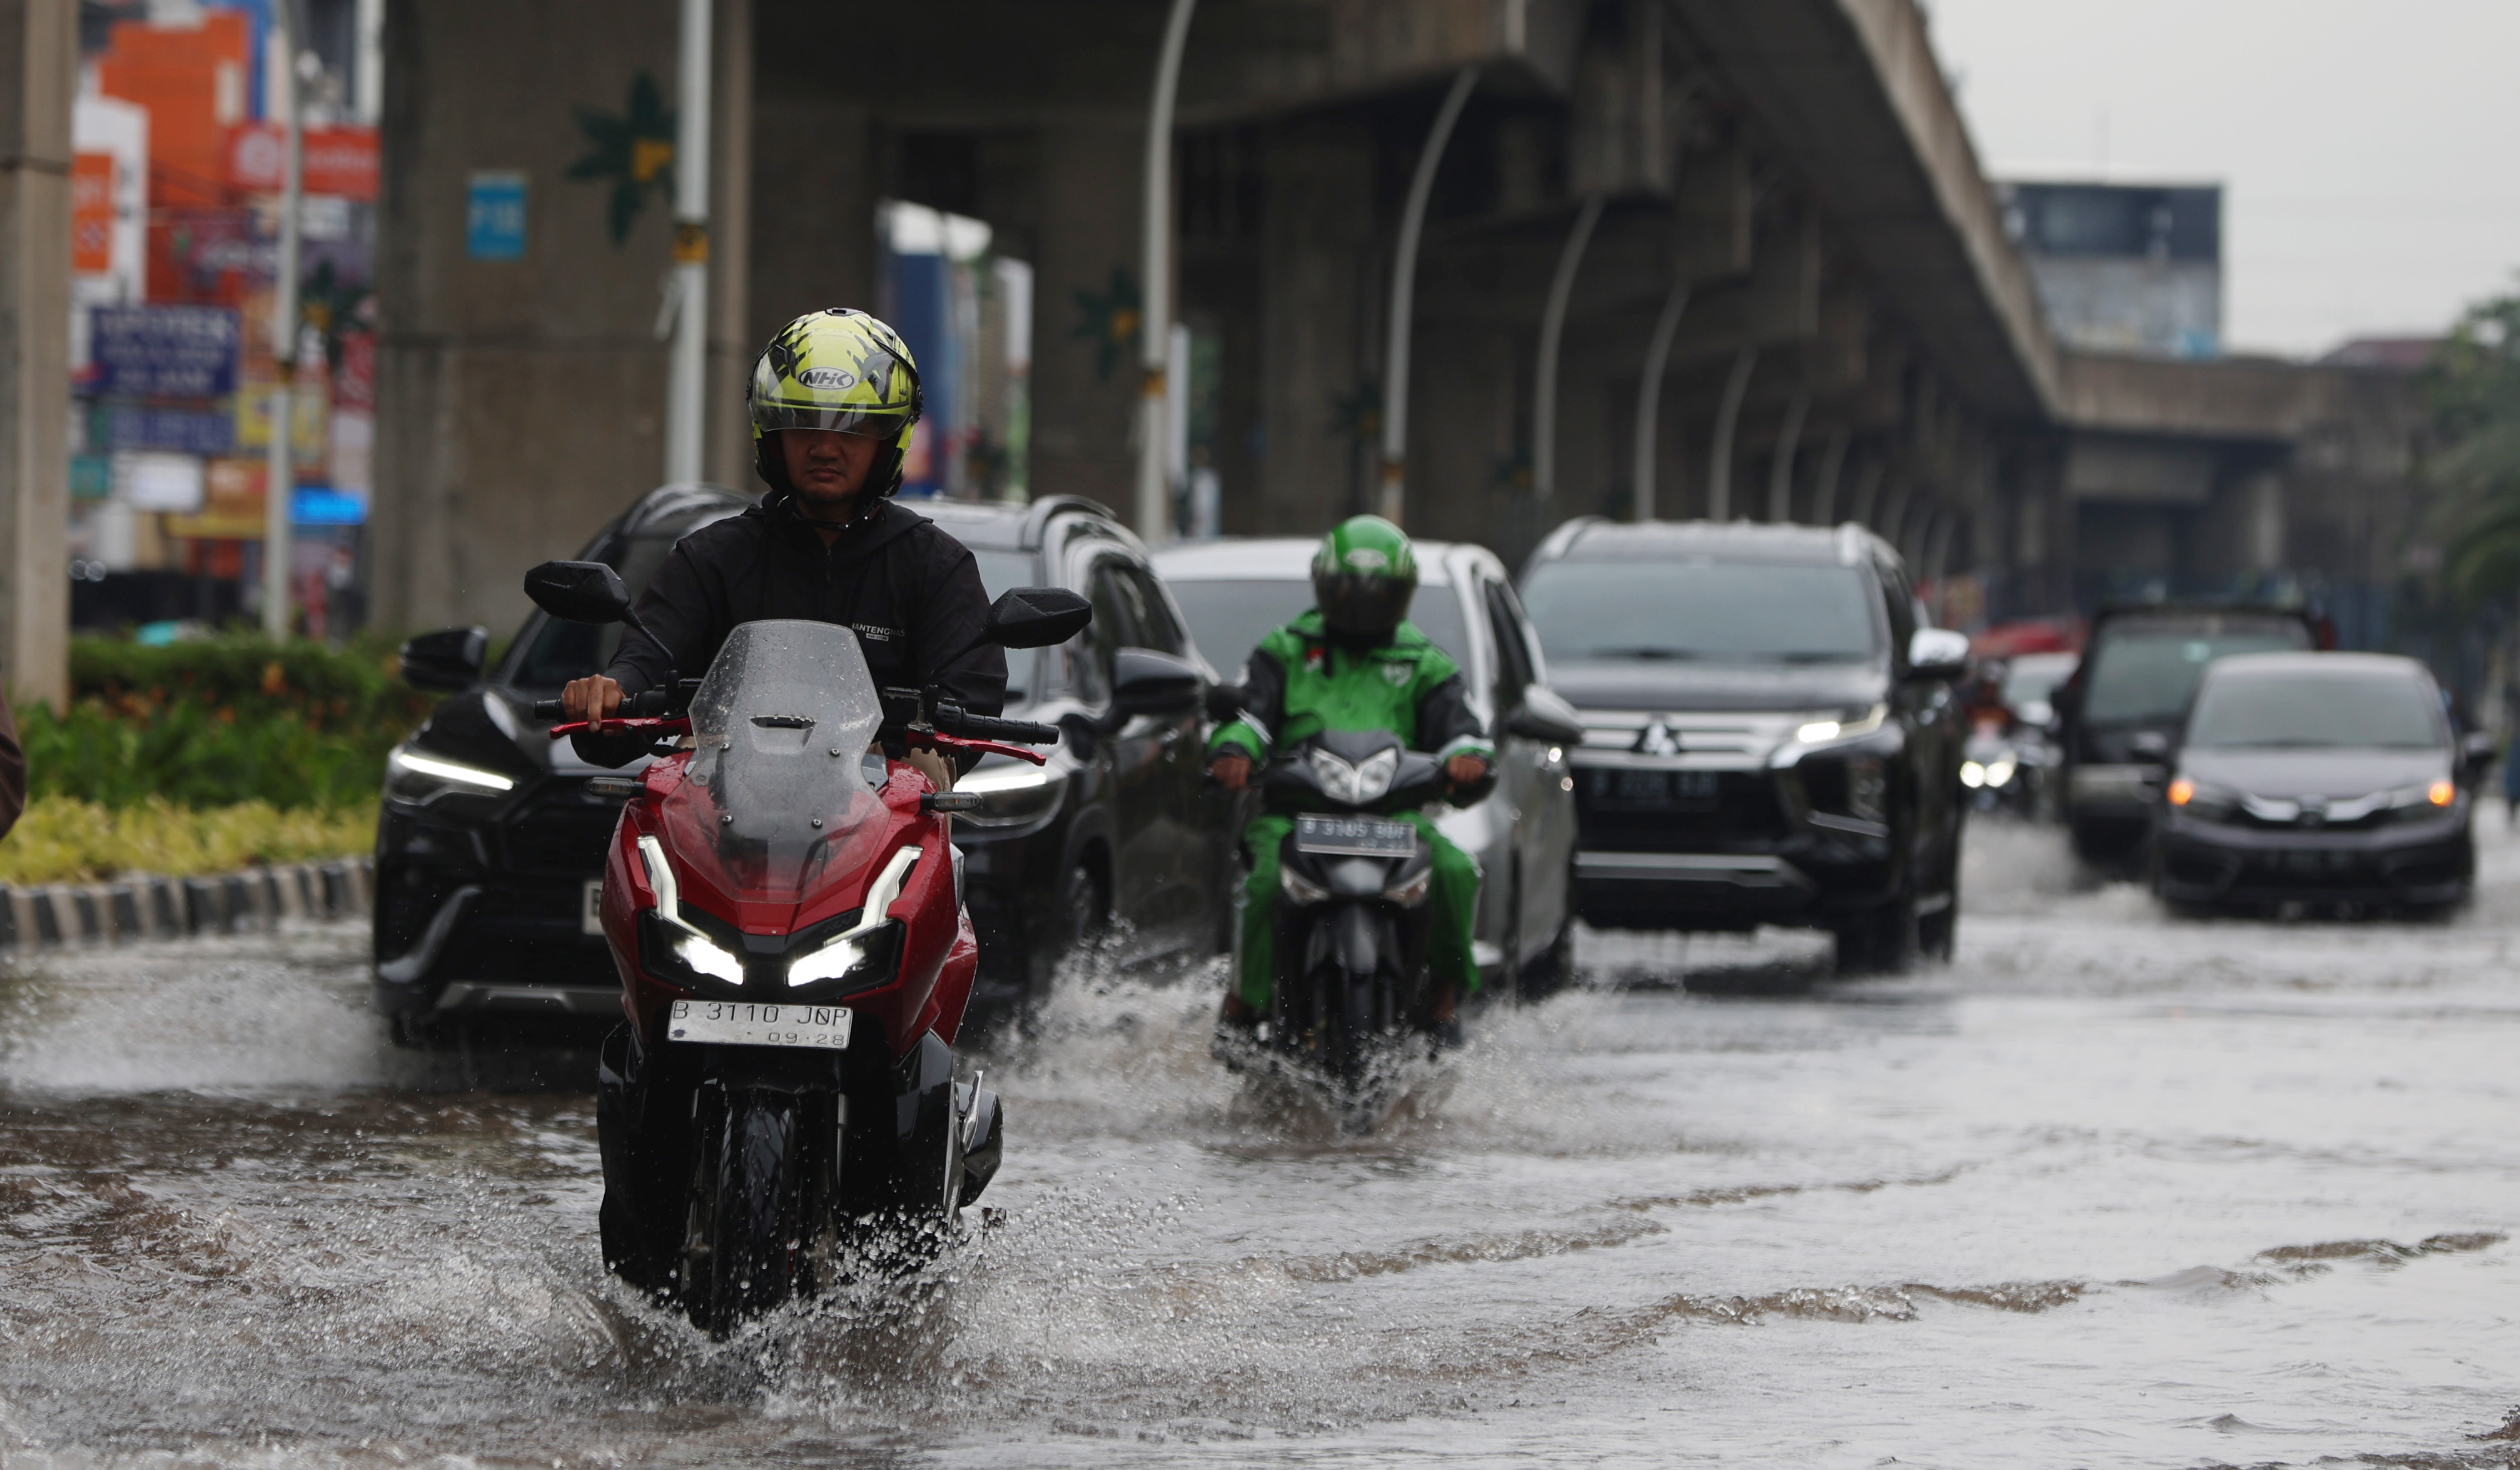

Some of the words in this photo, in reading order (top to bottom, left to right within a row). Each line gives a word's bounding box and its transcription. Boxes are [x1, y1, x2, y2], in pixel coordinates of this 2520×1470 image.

[802, 371, 849, 386] NHK
[673, 1001, 688, 1019] B
[707, 1003, 779, 1023] 3110
